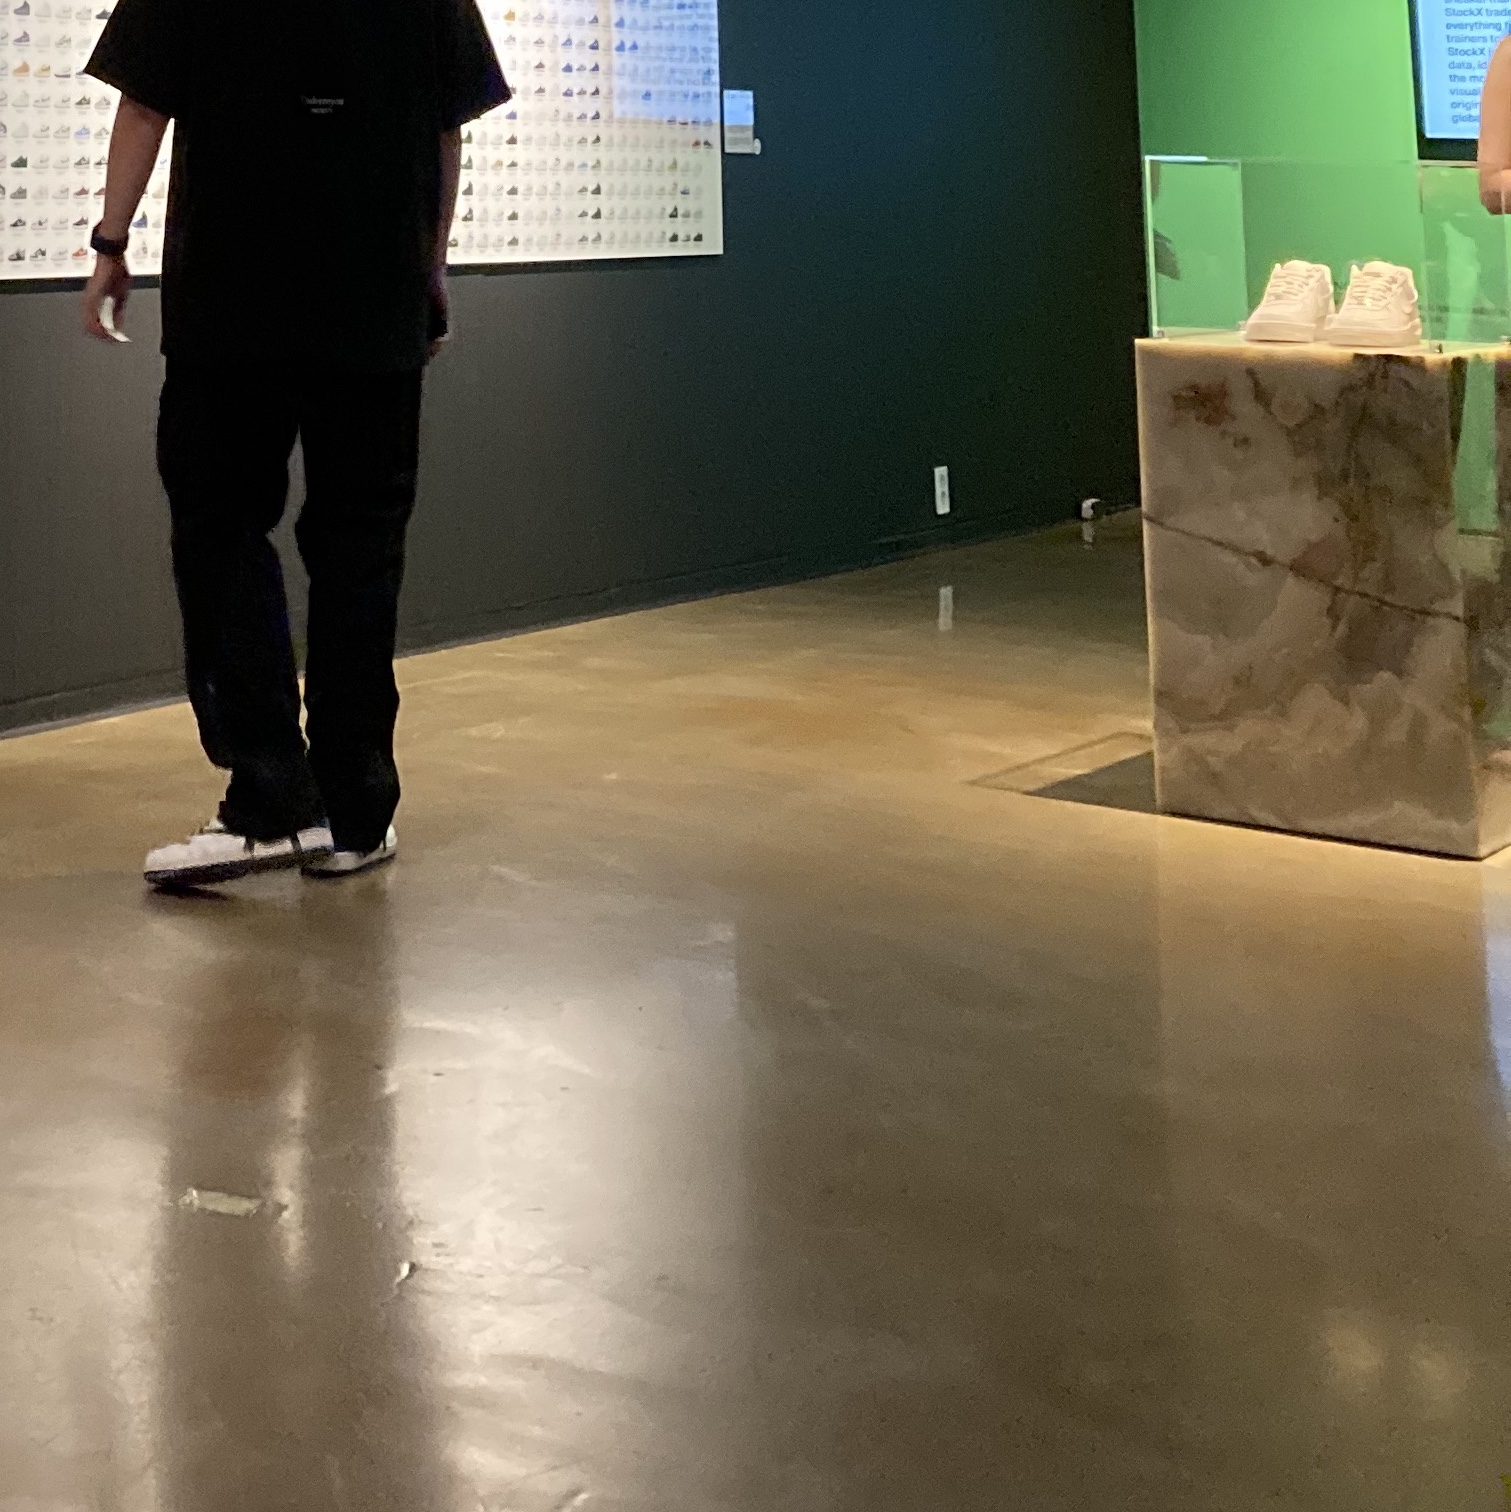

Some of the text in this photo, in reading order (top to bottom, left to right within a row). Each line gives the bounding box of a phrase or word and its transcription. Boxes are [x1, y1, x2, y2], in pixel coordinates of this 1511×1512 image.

[1445, 7, 1483, 17] StockX
[1446, 21, 1502, 32] everything
[1446, 34, 1488, 43] trainers
[1448, 47, 1486, 56] StockX
[1448, 61, 1475, 71] data,
[1449, 74, 1466, 83] the
